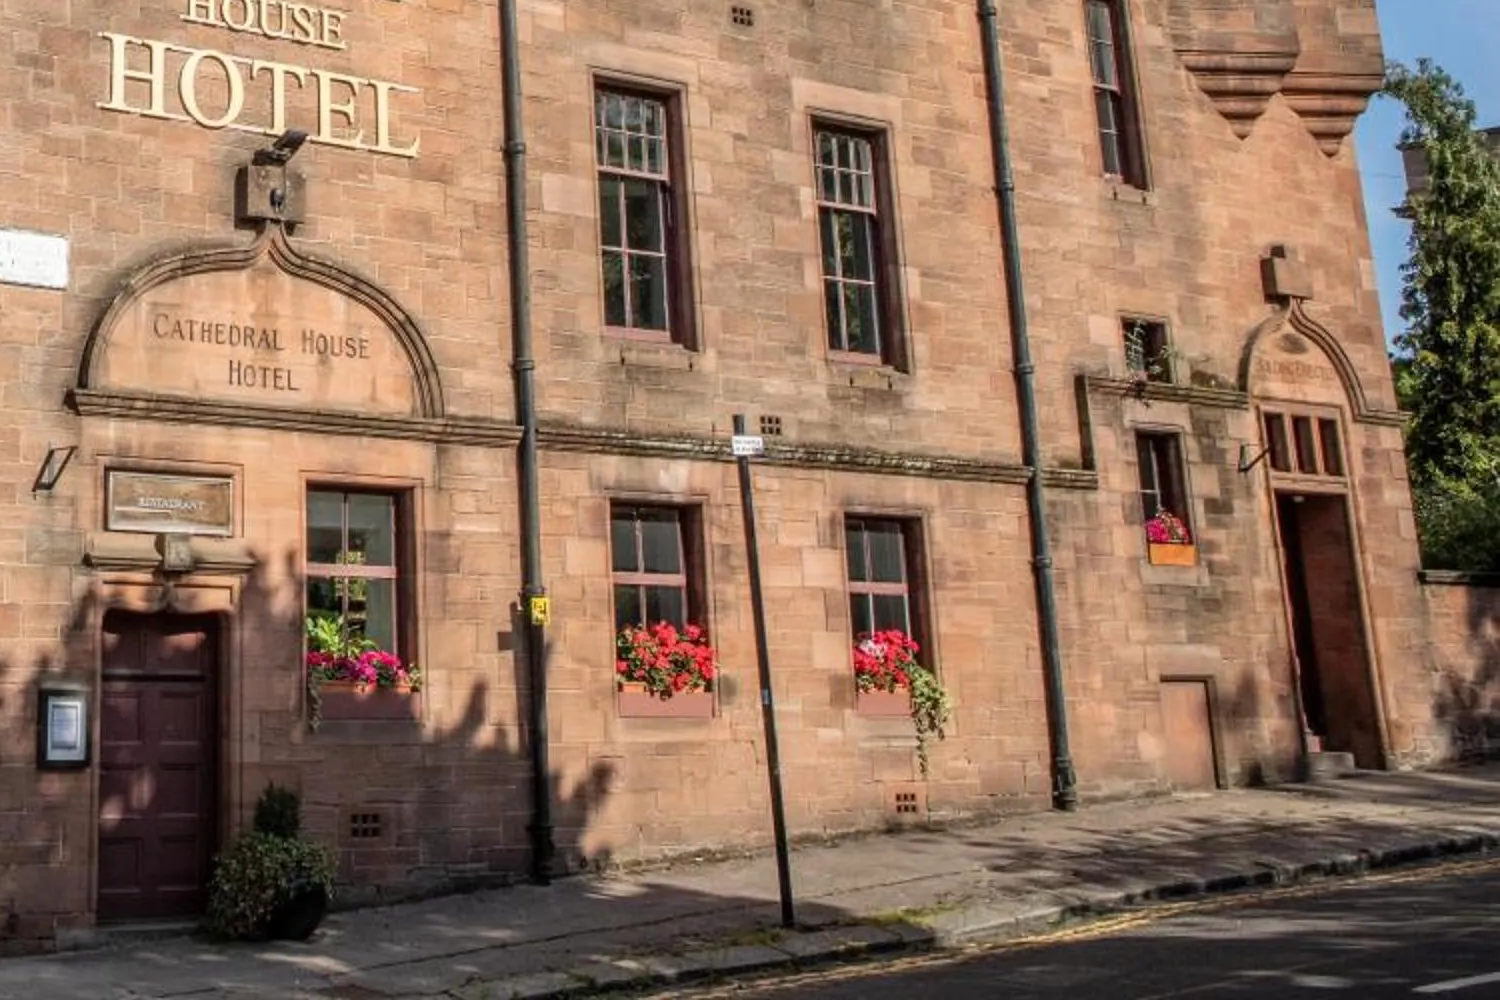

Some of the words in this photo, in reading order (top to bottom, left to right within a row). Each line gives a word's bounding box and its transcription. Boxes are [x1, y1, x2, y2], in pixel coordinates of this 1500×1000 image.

[96, 31, 423, 158] HOTEL
[153, 312, 285, 351] CATHEDRAL
[301, 329, 370, 359] HOUSE
[228, 360, 300, 392] HOTEL
